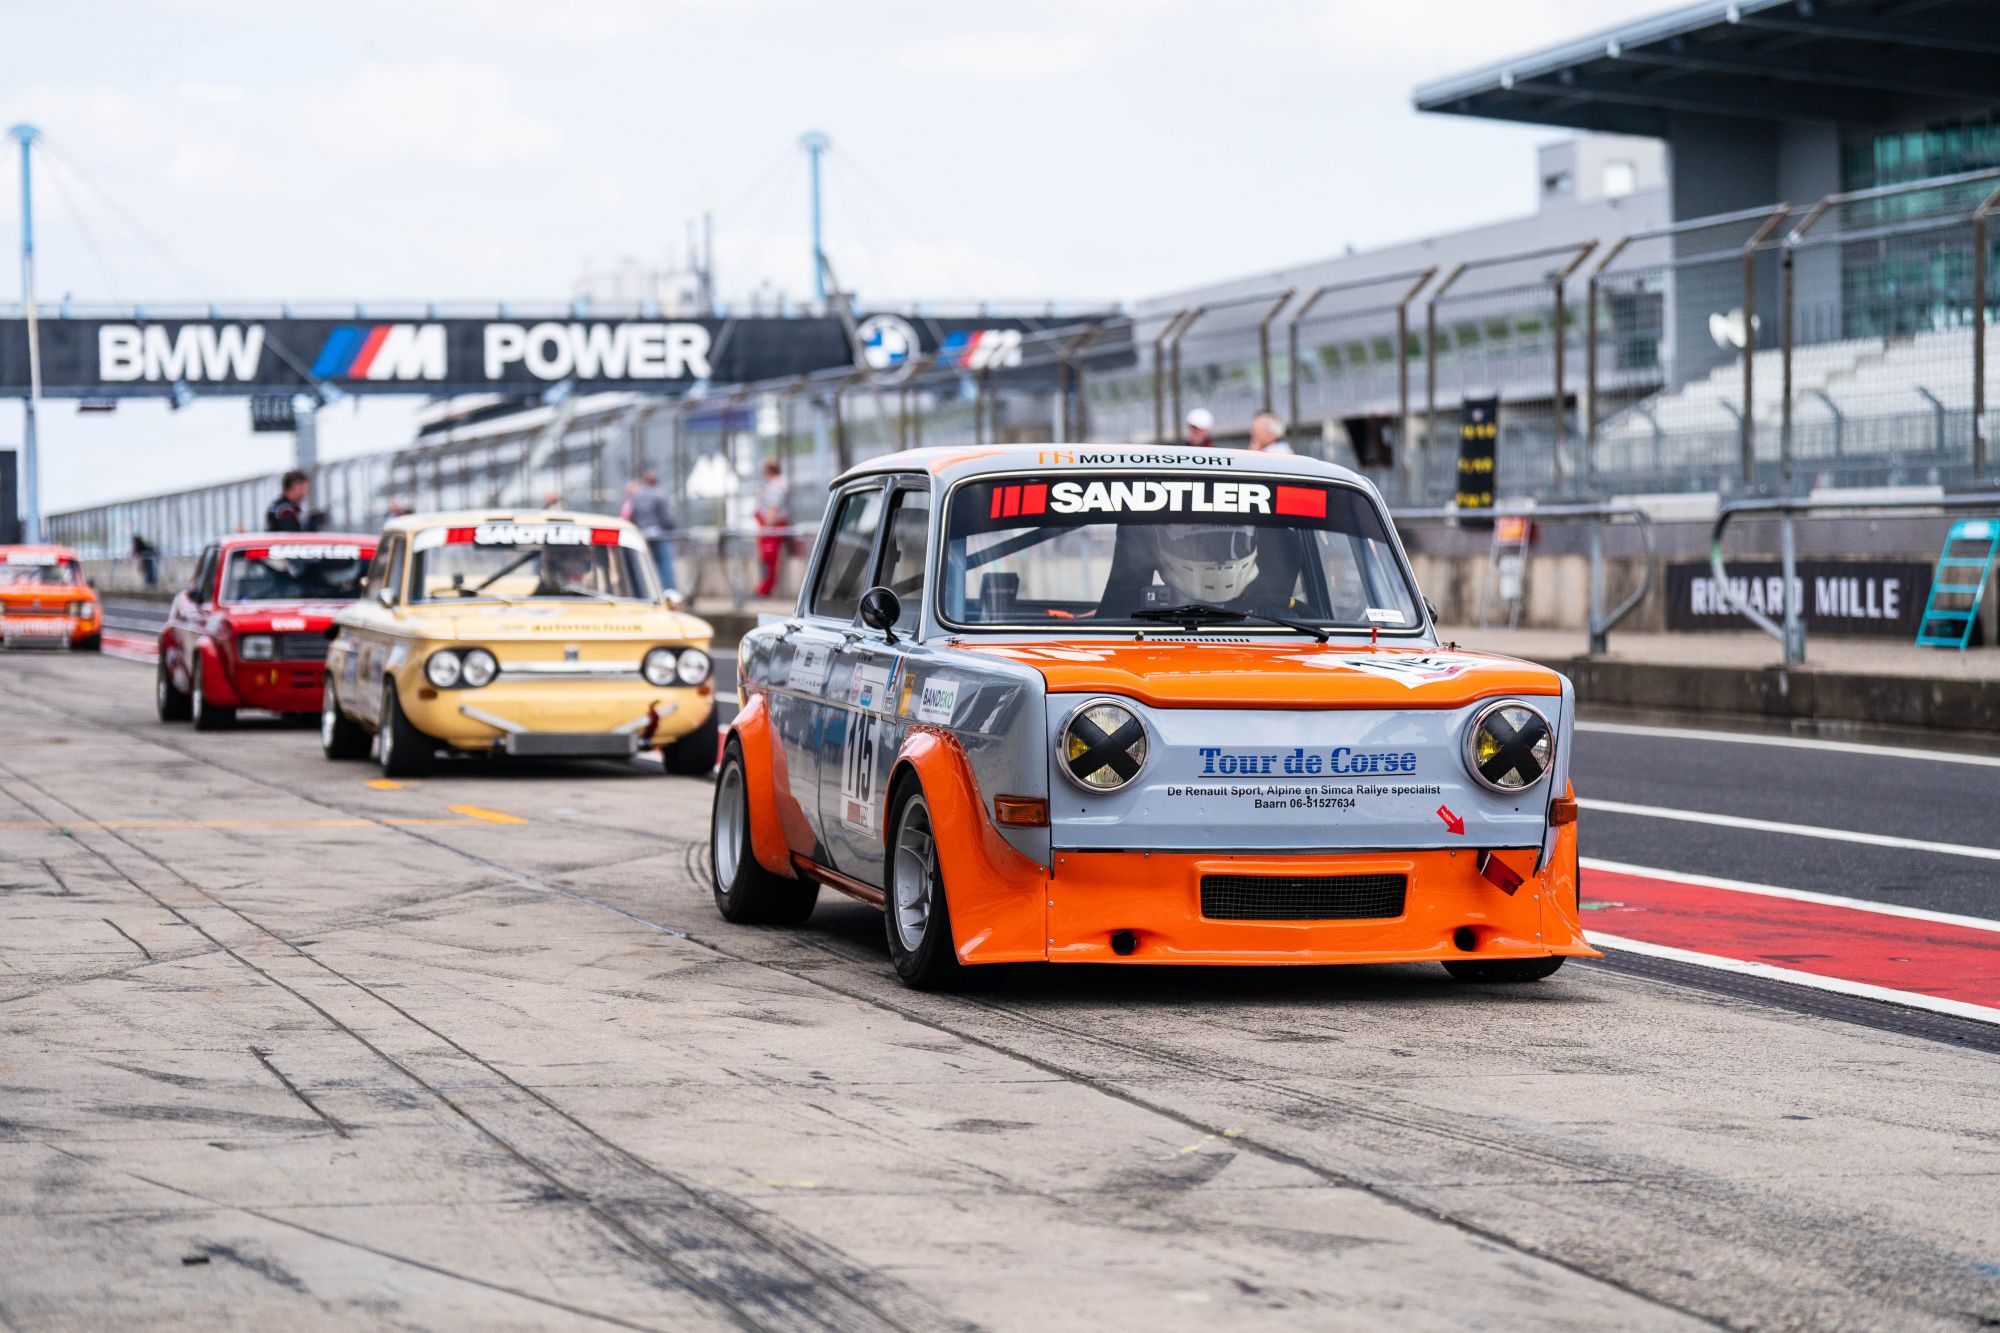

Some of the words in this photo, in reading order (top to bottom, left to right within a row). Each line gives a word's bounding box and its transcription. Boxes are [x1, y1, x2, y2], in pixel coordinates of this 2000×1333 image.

[98, 324, 265, 381] BMW
[483, 322, 711, 380] POWER
[1079, 454, 1235, 466] MOTORSPORT
[1050, 481, 1272, 514] SANDTLER
[1815, 576, 1900, 619] MILLE
[848, 711, 877, 802] 115
[1199, 748, 1278, 774] Tour
[1283, 748, 1323, 774] de
[1330, 746, 1417, 773] Corse
[1167, 786, 1182, 796] De
[1185, 786, 1228, 796] Renault
[1231, 785, 1264, 798] Sport,
[1266, 785, 1302, 797] Alpine
[1304, 787, 1318, 795] en
[1321, 784, 1353, 795] Simca
[1356, 784, 1389, 797] Rallye
[1391, 784, 1441, 797] specialist
[1254, 799, 1287, 809] Baarn
[1289, 798, 1356, 809] 06-51527634
